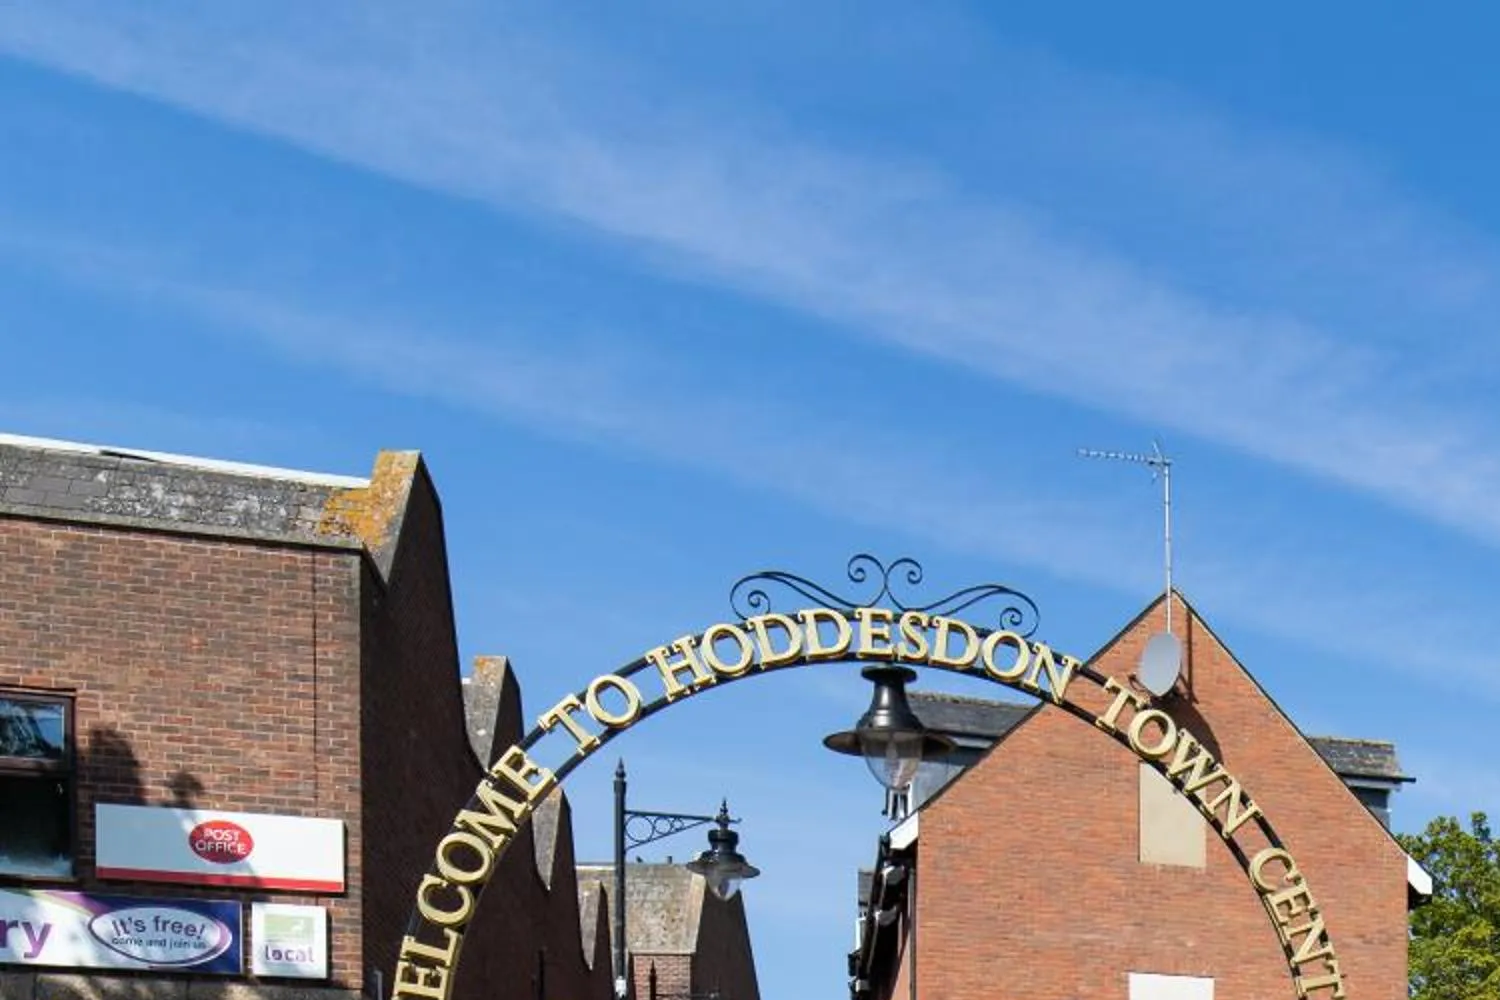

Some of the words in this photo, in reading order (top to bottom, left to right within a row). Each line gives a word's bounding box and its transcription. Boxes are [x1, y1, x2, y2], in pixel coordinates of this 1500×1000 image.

[537, 673, 641, 756] TO
[646, 607, 1081, 705] HODDESDON
[1095, 676, 1263, 839] TOWN
[203, 827, 239, 842] POST
[195, 839, 247, 855] OFFICE
[111, 917, 146, 936] It's
[153, 915, 205, 939] free!
[265, 944, 314, 963] local
